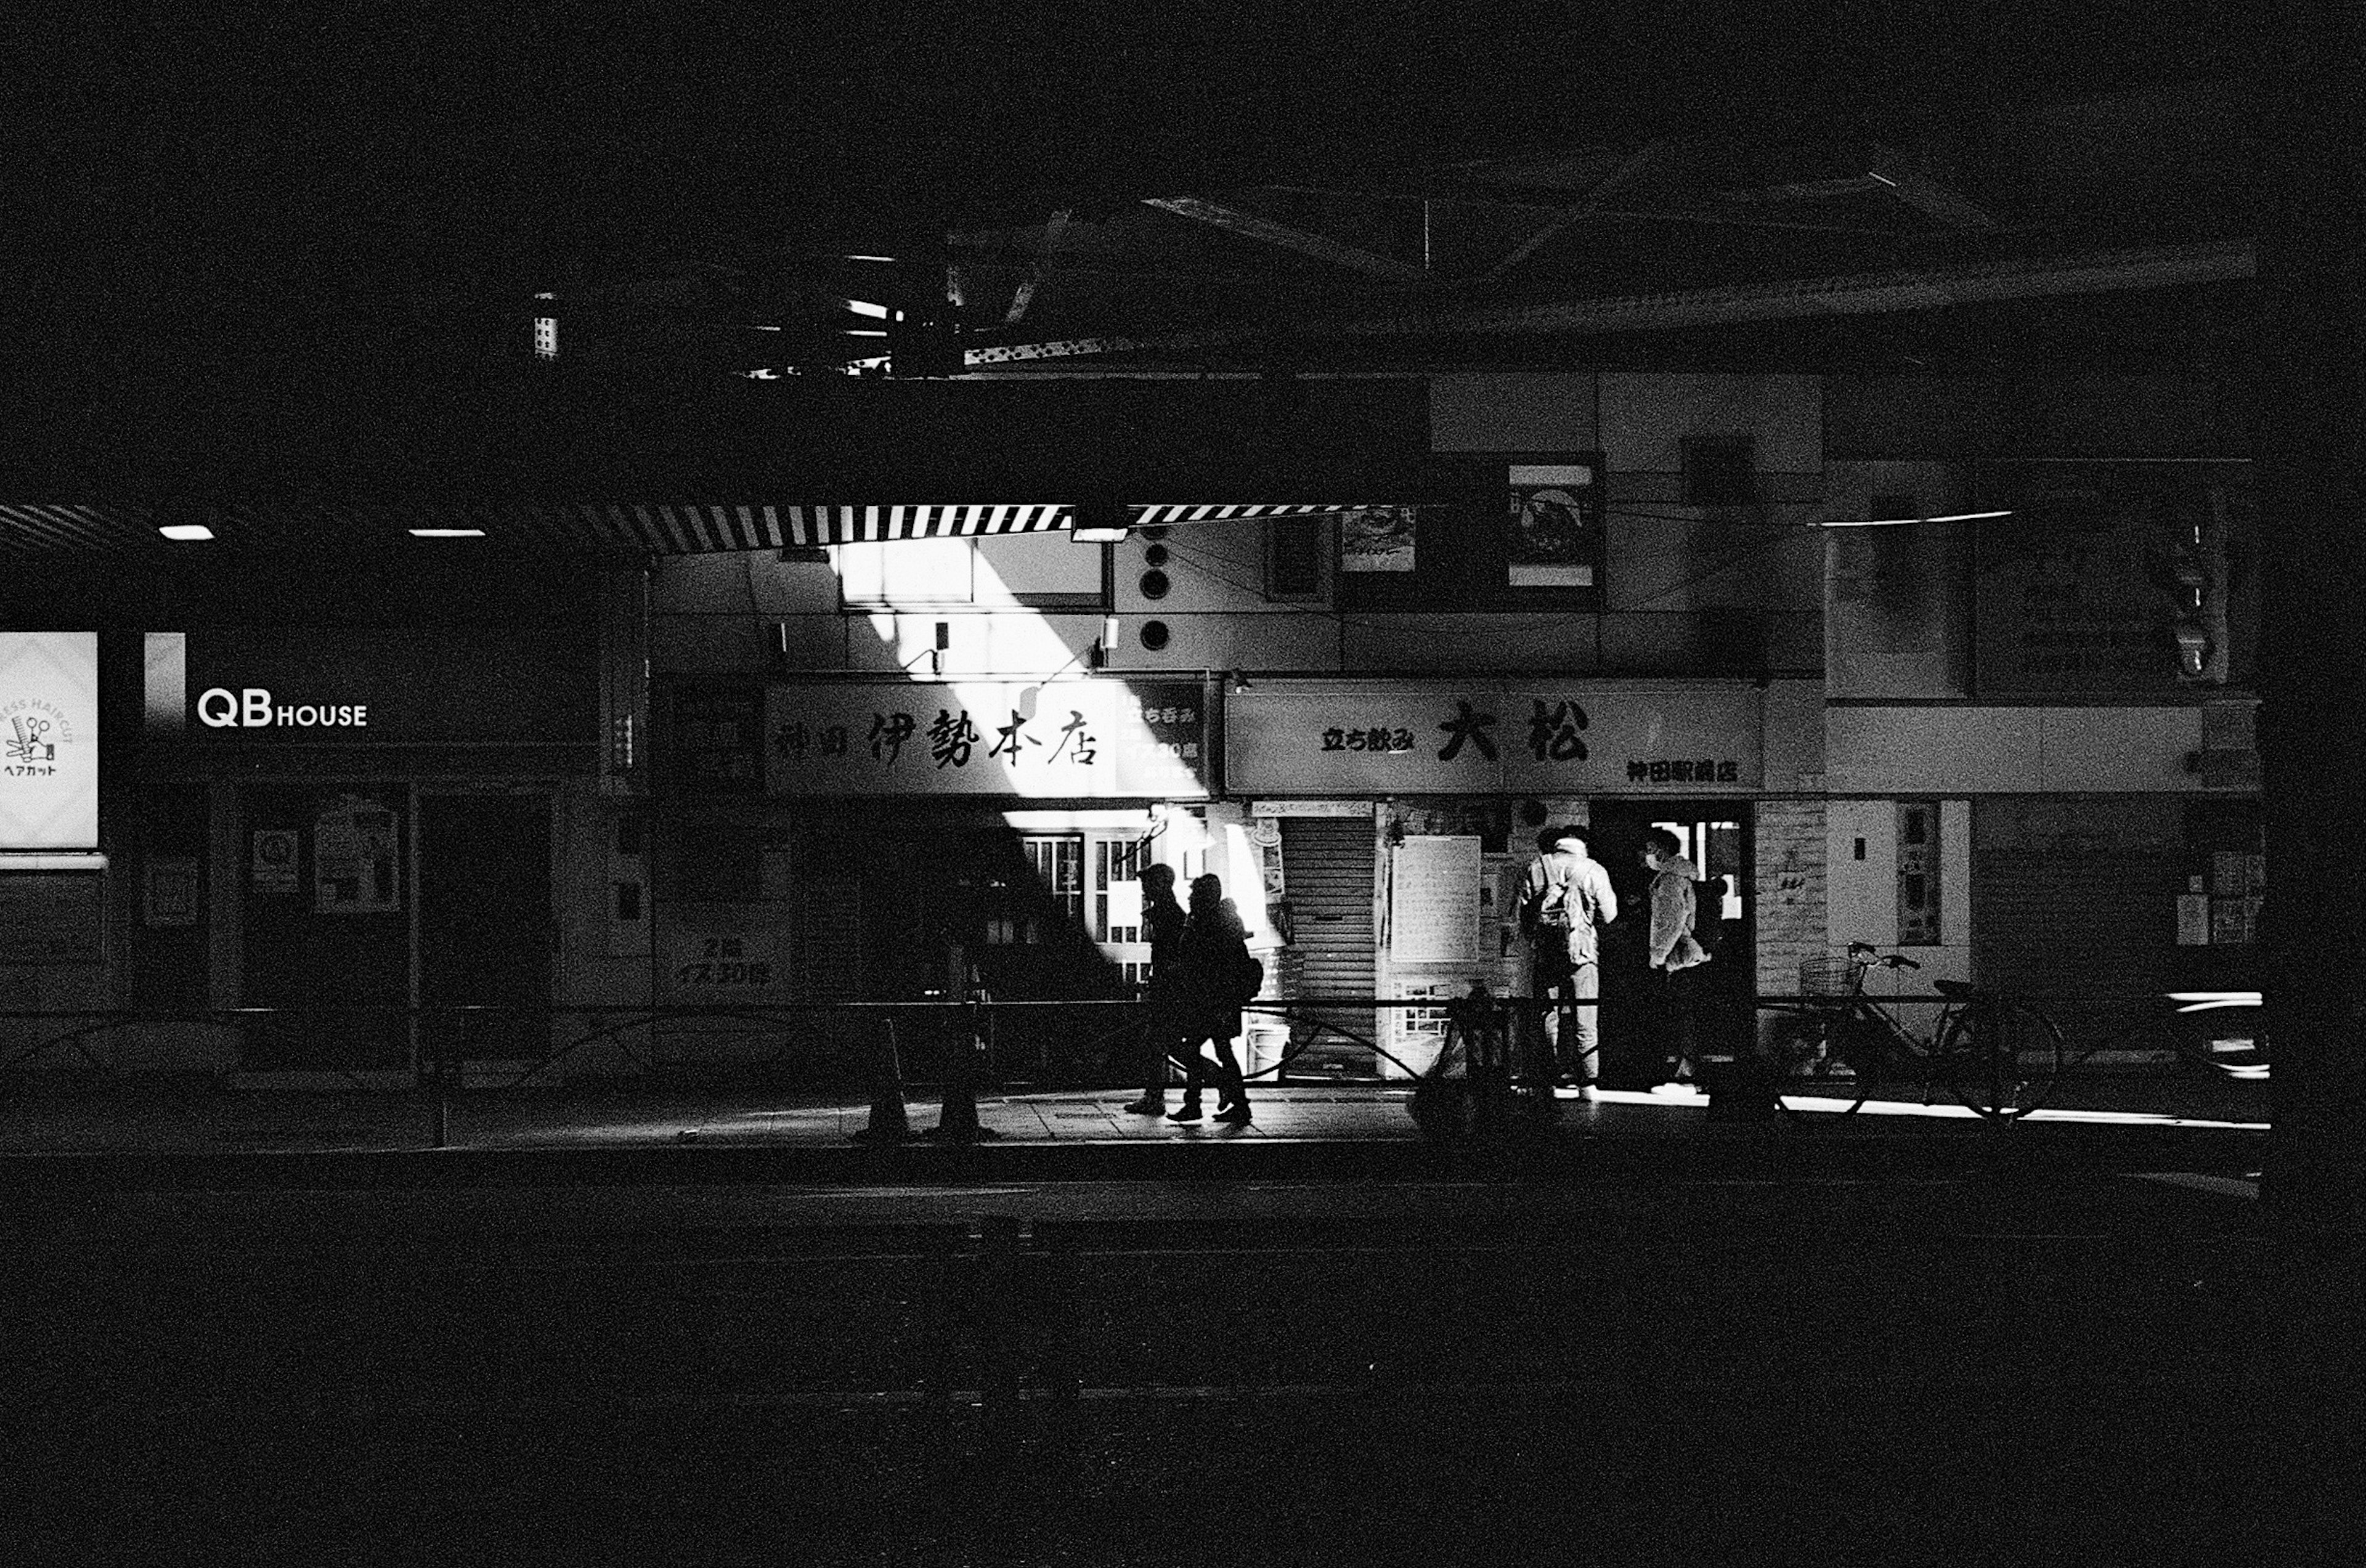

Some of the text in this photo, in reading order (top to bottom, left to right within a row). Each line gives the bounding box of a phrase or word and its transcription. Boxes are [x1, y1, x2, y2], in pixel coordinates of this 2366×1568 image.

[198, 688, 367, 727] QB HOUSE
[868, 709, 1097, 770] 伊勢本店
[1321, 727, 1415, 752] 立ち飲み
[1437, 700, 1588, 760] 大松
[4, 766, 56, 776] ヘアカット
